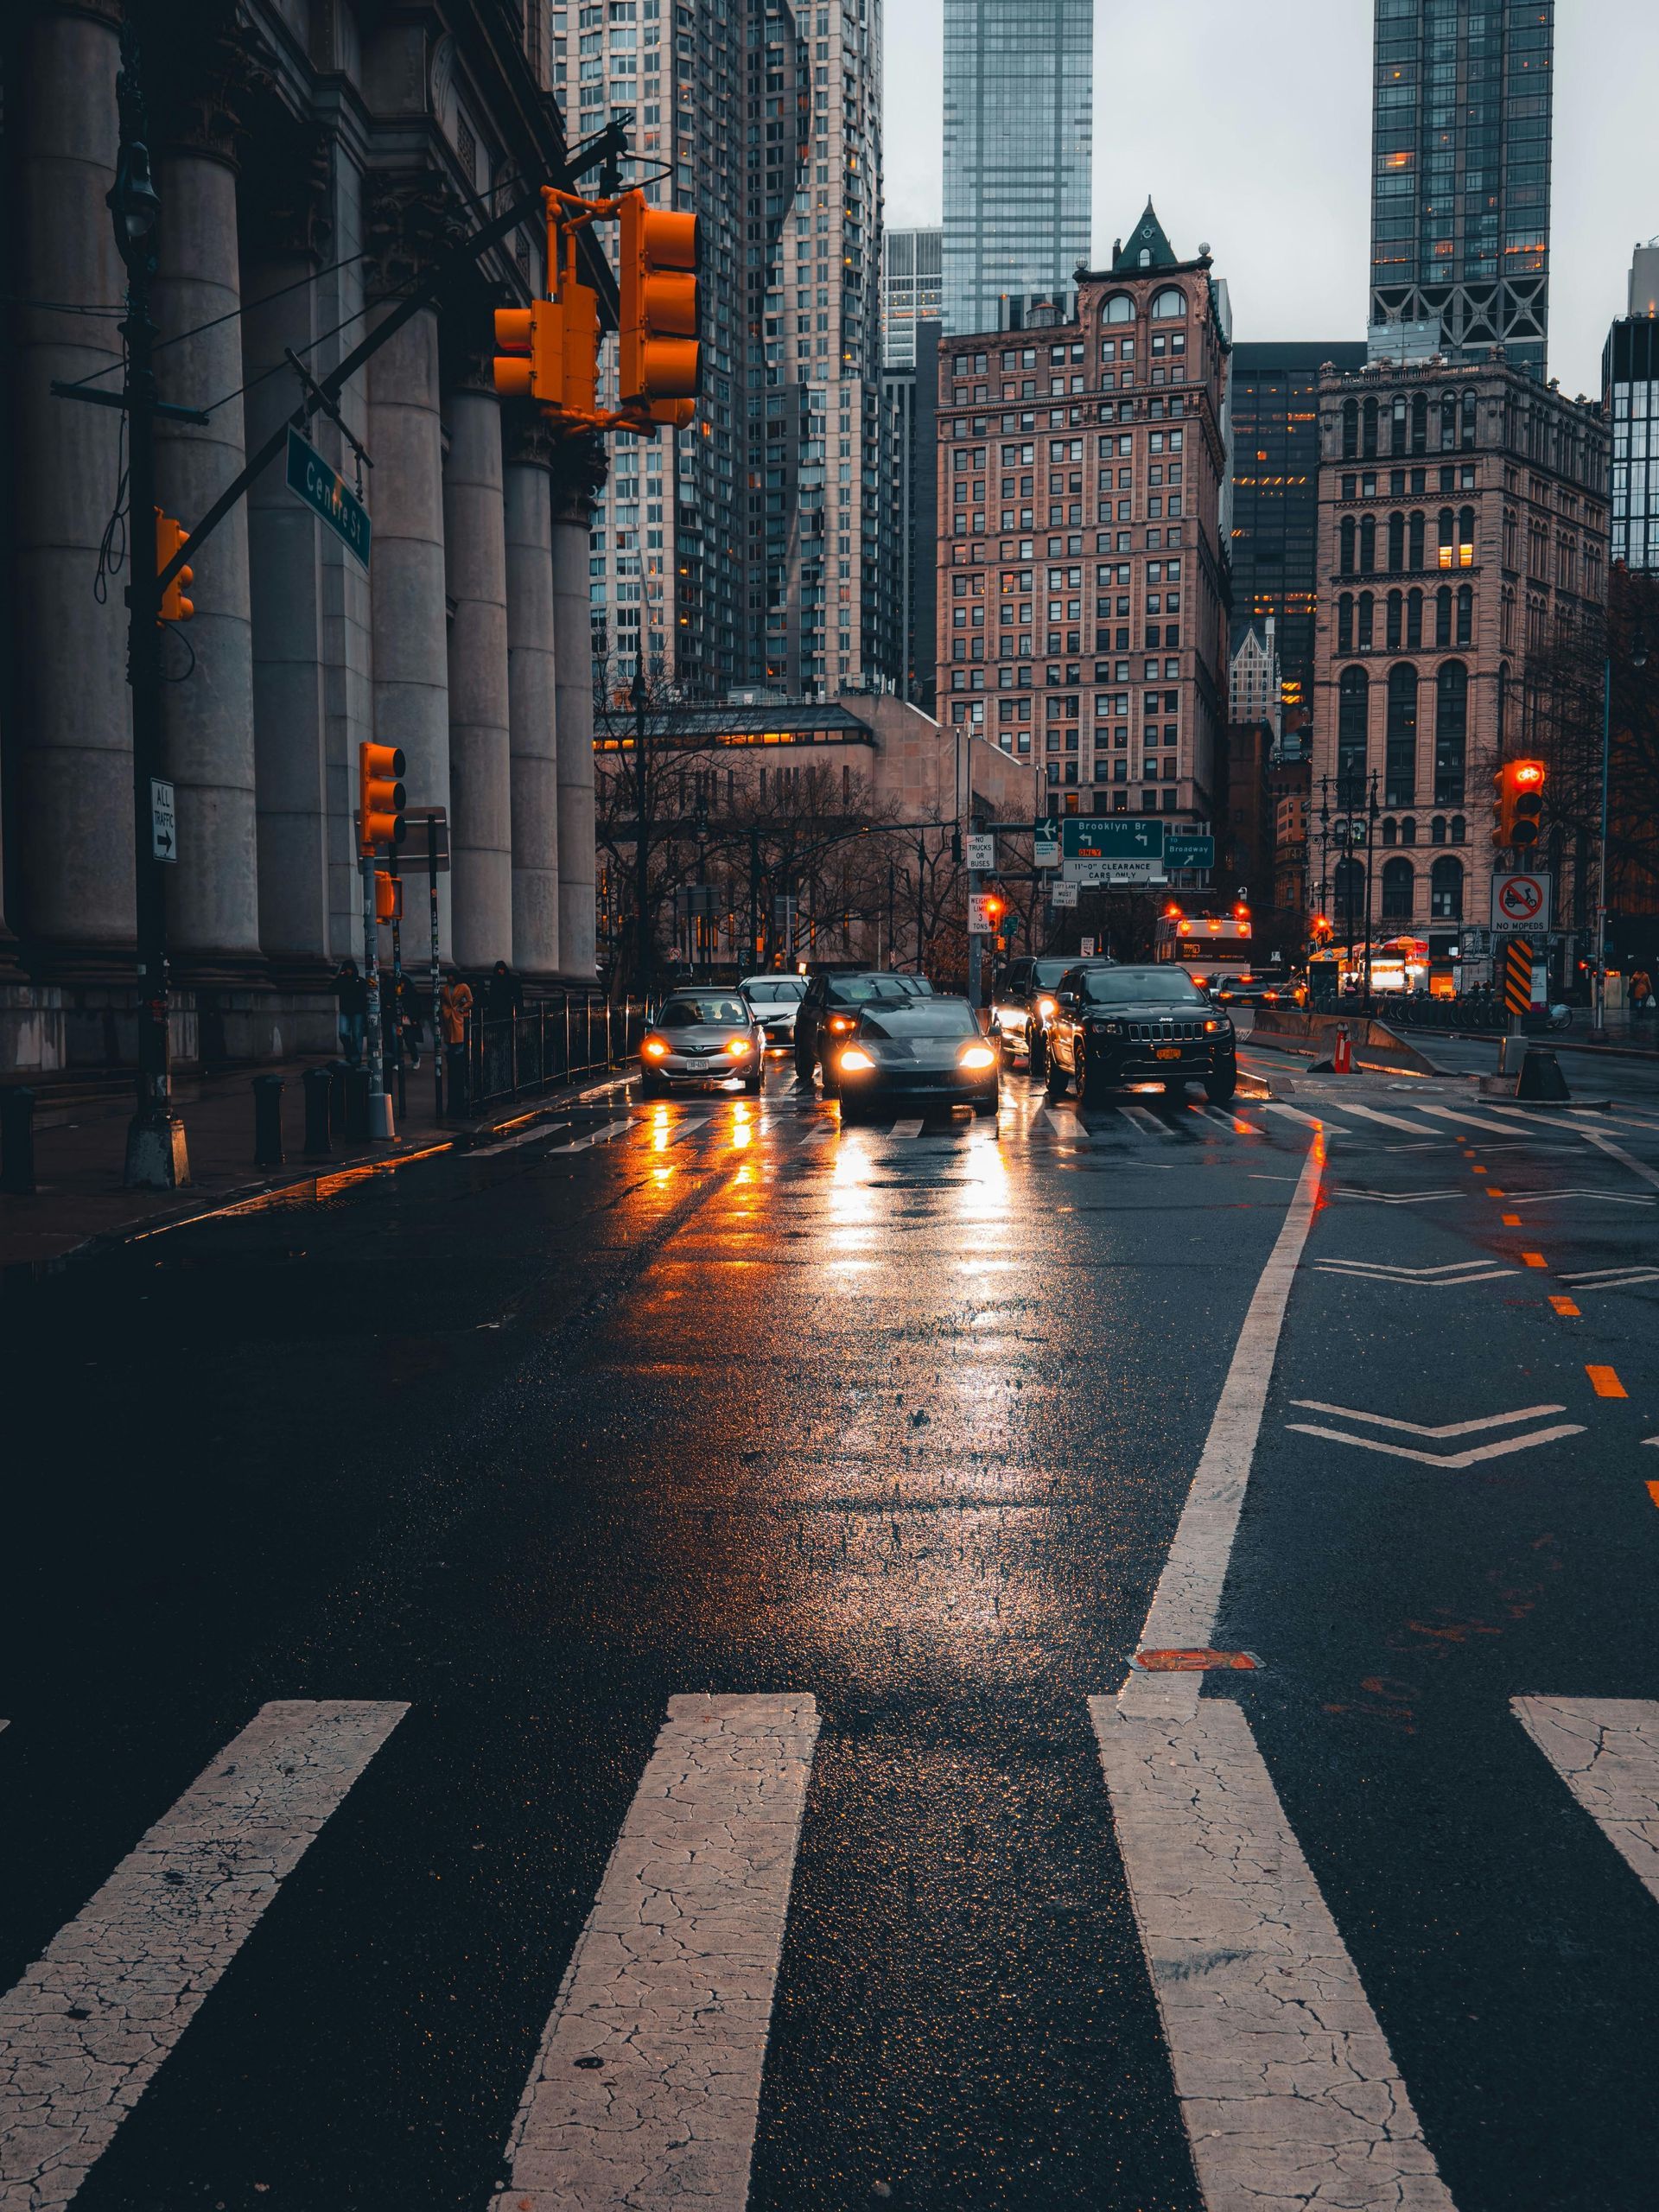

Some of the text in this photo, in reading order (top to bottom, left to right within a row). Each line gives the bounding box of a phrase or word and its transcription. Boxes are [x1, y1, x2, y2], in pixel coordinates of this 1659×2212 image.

[306, 461, 361, 545] Centre St
[156, 786, 170, 808] ALL
[154, 810, 174, 829] TRAFFIC
[1078, 822, 1147, 832] Brooklyn Br
[1169, 845, 1209, 854] Broadway
[978, 913, 983, 922] 3
